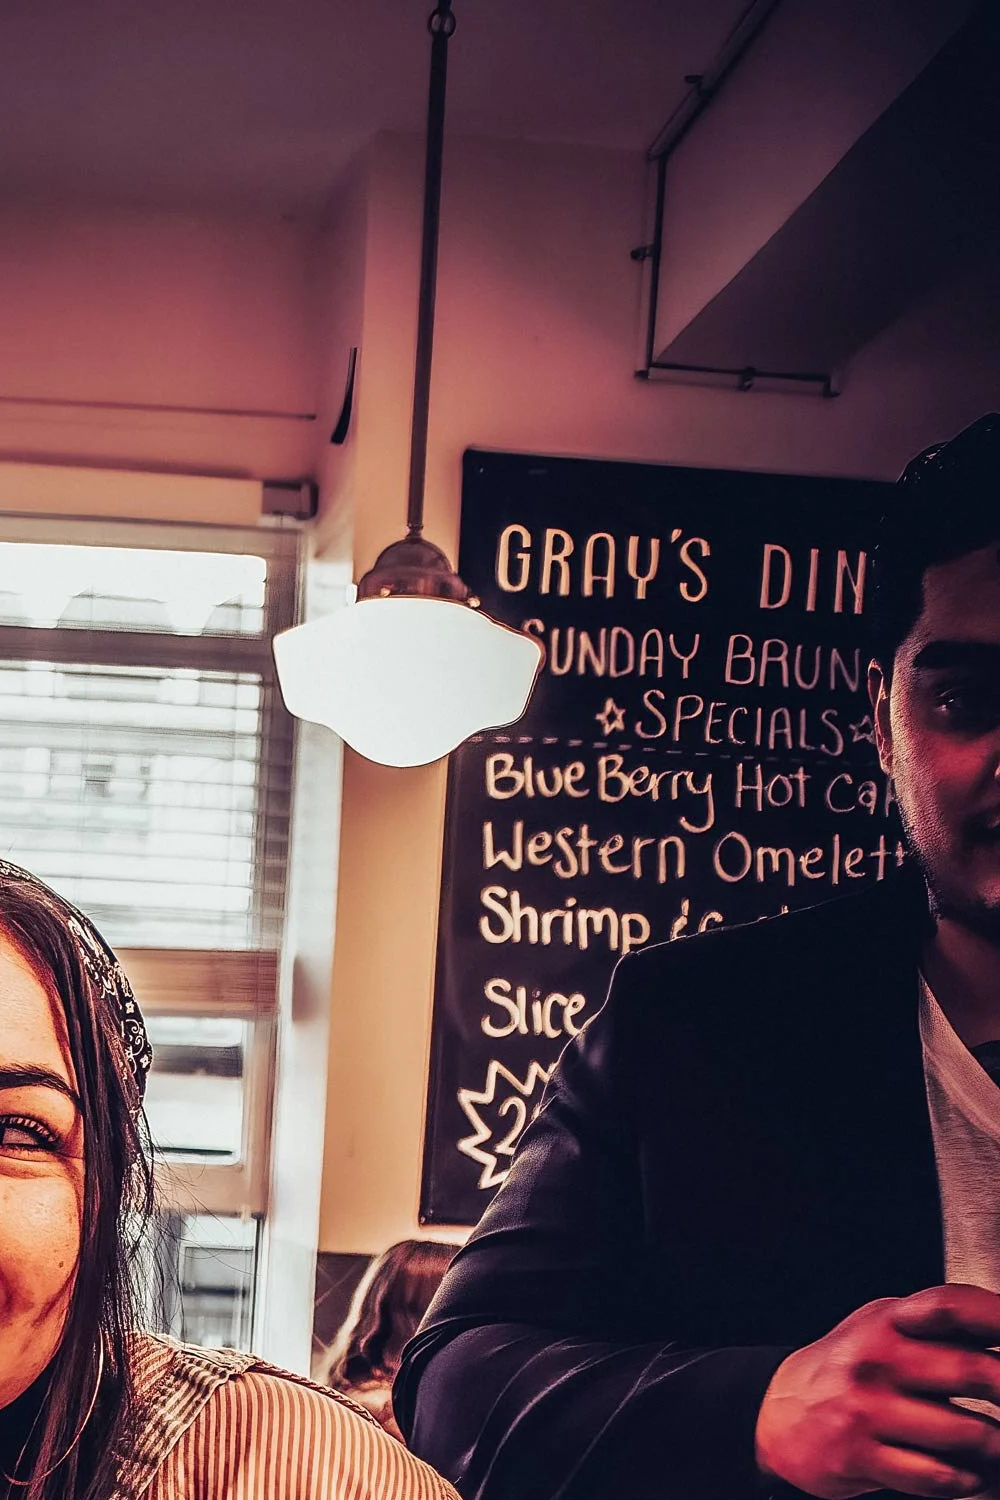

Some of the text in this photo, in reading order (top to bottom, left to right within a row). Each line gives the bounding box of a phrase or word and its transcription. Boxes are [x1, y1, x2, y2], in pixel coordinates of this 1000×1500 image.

[497, 523, 867, 614] GRAY'S DIN
[522, 618, 860, 692] SUNDAY BRUN
[635, 689, 844, 756] SPECIALS
[486, 753, 591, 800] Blue
[597, 754, 715, 831] Berry
[735, 762, 811, 811] Hot
[481, 820, 686, 883] Western
[479, 886, 651, 954] Shrimp
[480, 978, 587, 1038] Slice
[494, 1096, 541, 1156] 2
